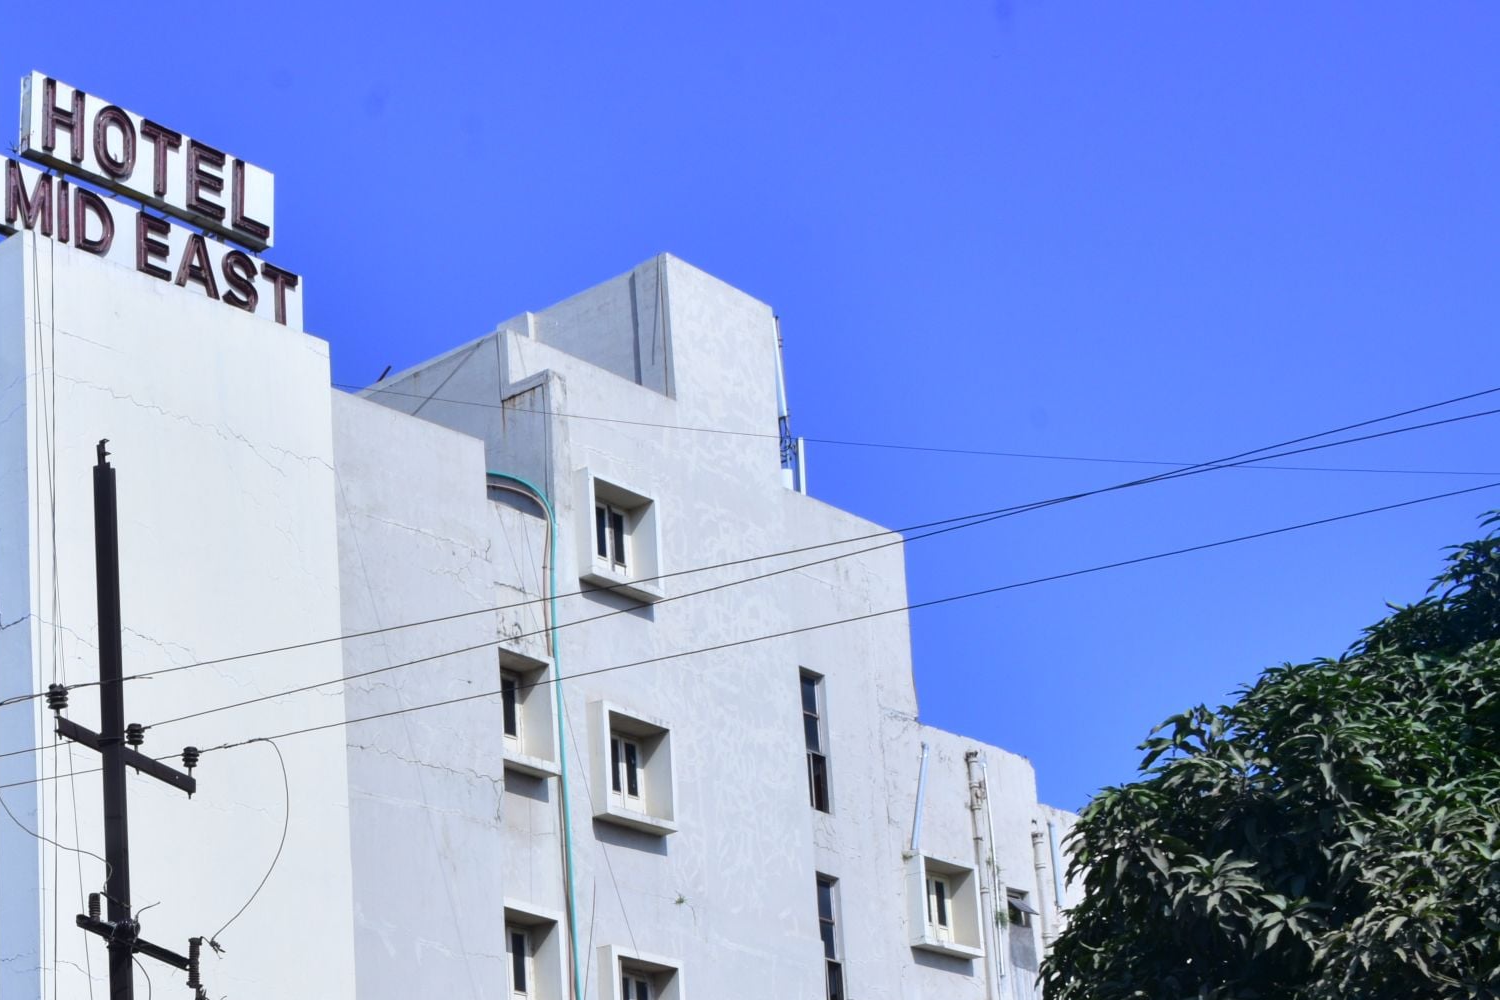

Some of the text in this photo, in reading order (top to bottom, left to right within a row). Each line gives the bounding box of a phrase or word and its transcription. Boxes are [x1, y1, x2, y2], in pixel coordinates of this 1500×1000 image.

[41, 76, 271, 240] HOTEL
[4, 158, 299, 326] MID EAST
